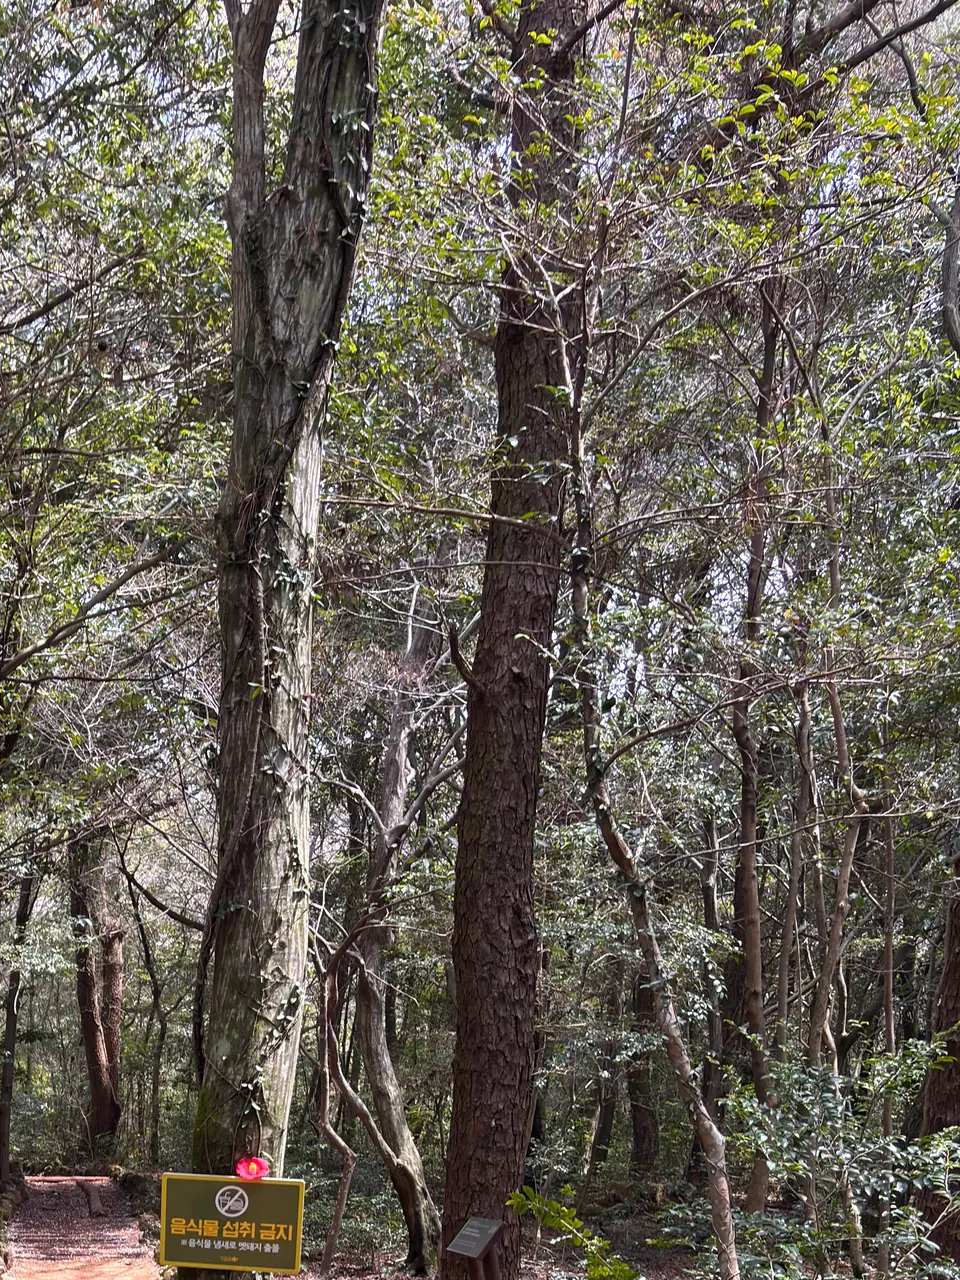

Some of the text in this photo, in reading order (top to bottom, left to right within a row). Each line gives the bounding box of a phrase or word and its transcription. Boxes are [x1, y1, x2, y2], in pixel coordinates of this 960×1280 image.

[170, 1217, 293, 1241] 음식물 섭취 금지
[188, 1238, 211, 1248] 음식물
[213, 1239, 237, 1250] 냄새로
[238, 1241, 262, 1252] 멧돼지
[263, 1243, 280, 1254] 출몰
